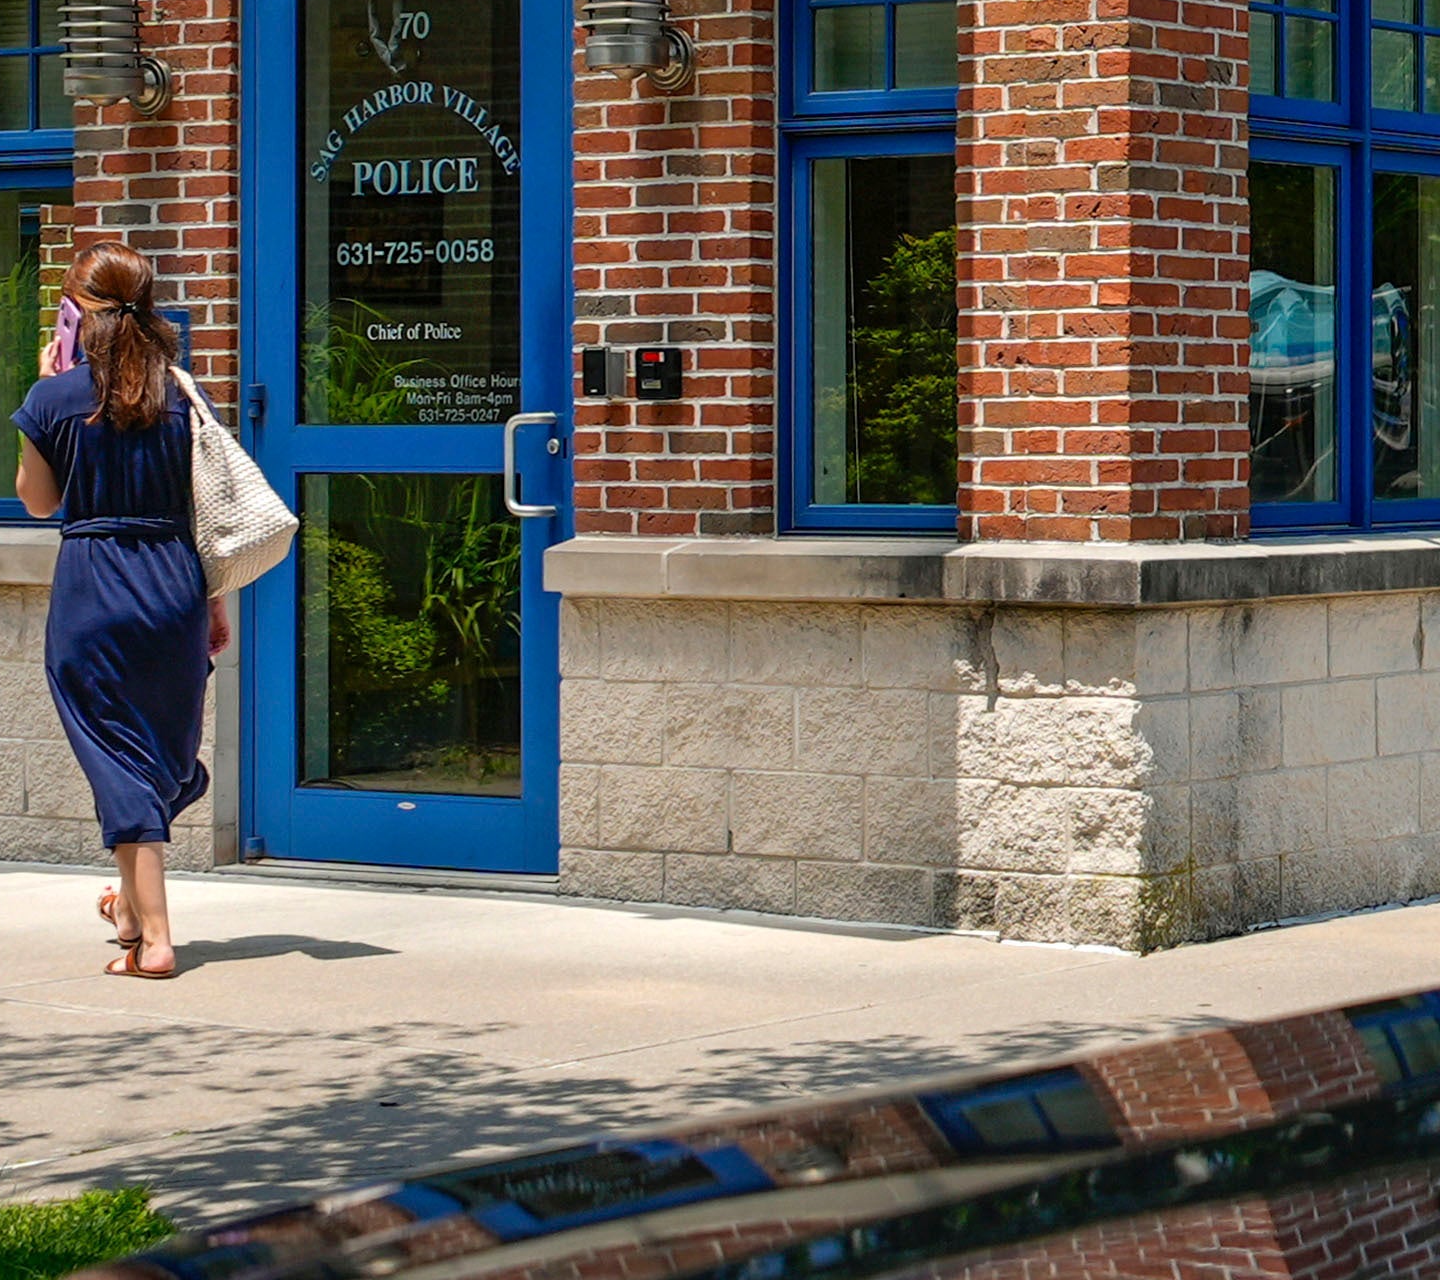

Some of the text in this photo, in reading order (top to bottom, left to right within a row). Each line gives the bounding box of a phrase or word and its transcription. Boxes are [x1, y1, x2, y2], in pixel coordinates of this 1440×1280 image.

[399, 11, 430, 39] 70
[310, 80, 522, 183] SAG HARBOR VILLAGE
[351, 157, 480, 197] POLICE
[336, 238, 495, 266] 631-725-0058
[367, 323, 462, 340] Chief of Police
[394, 374, 446, 388] Business
[450, 374, 486, 388] Office
[406, 391, 513, 407] Mon-Fri 8am-4pm
[419, 408, 500, 422] 631-725-0247
